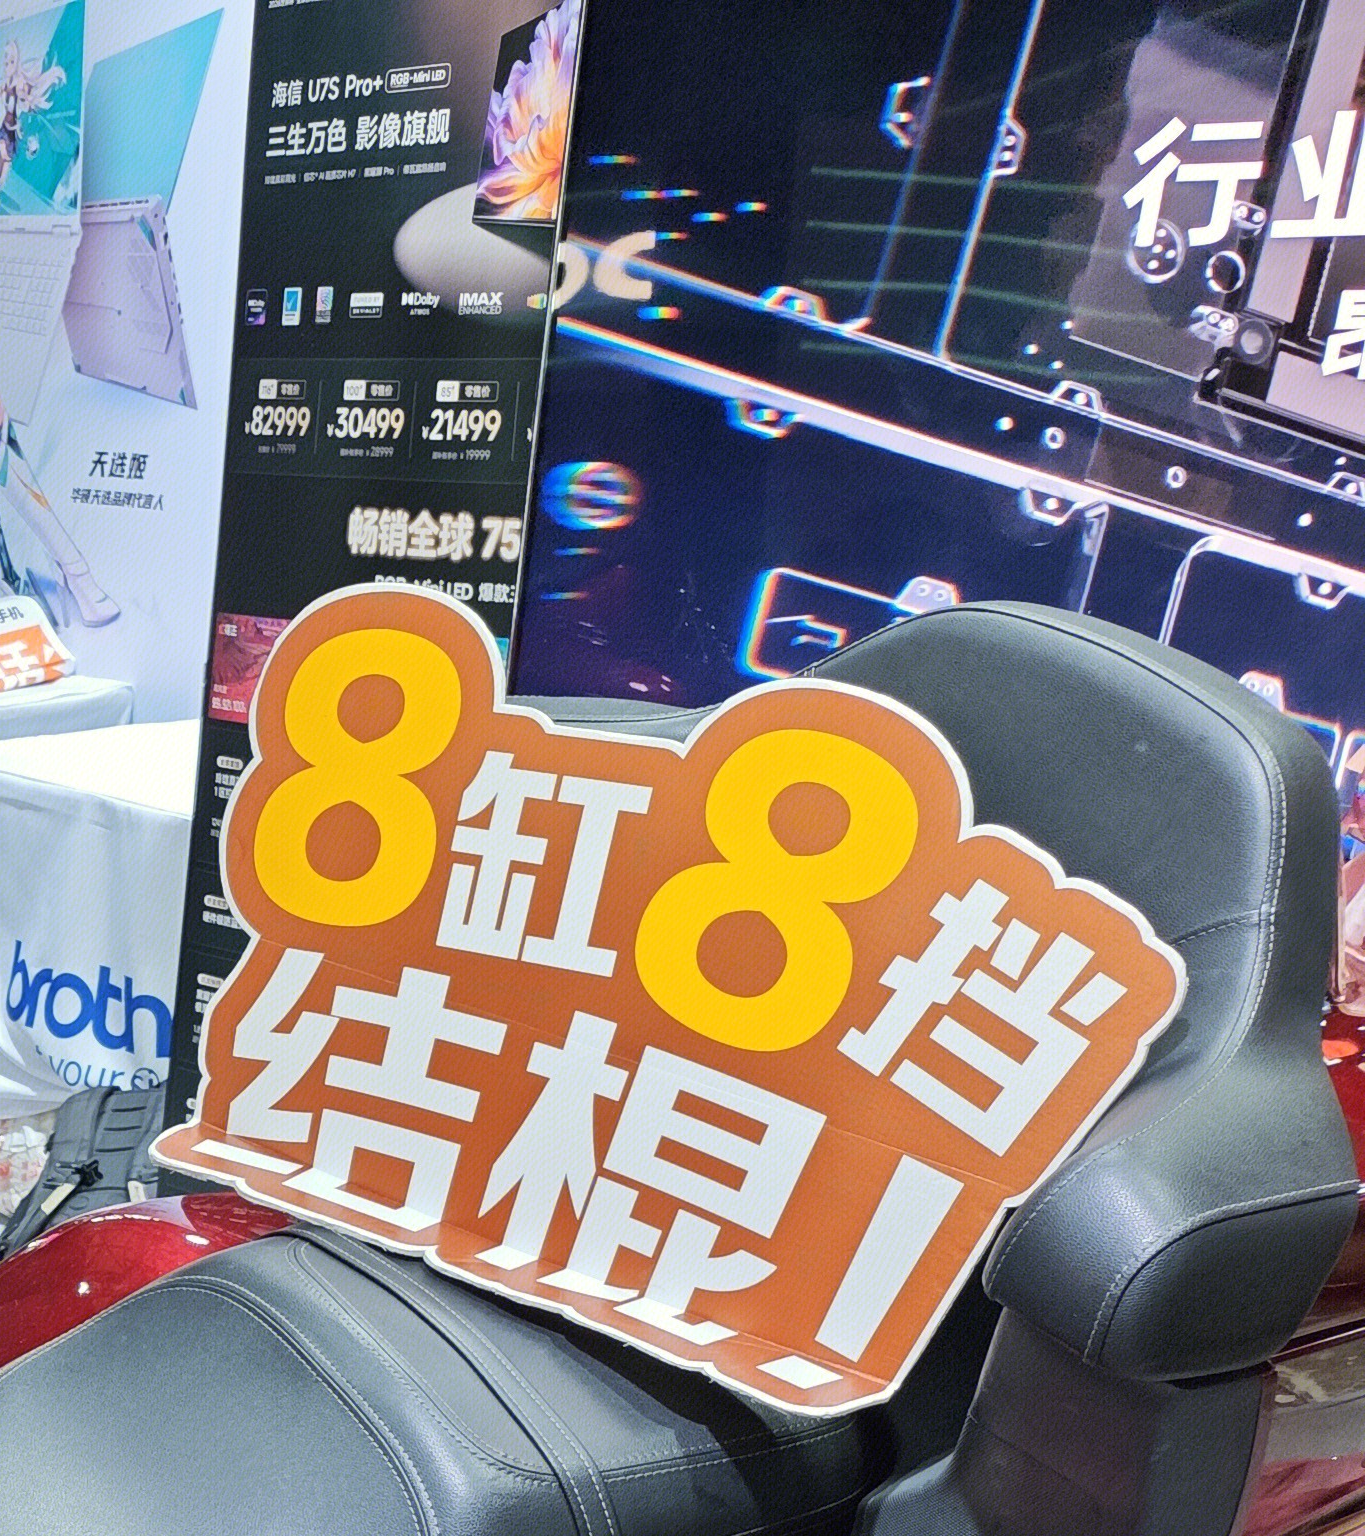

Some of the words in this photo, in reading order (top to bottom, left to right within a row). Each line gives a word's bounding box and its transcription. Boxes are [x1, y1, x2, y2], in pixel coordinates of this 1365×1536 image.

[271, 79, 304, 109] 海信
[308, 76, 340, 103] U7S
[344, 73, 383, 99] Pro+
[265, 118, 347, 157] 三生万色
[355, 108, 451, 152] 影像旗舰
[414, 292, 440, 308] Dolby
[458, 305, 502, 315] ENHANCED
[459, 292, 503, 305] IMAX
[244, 404, 311, 437] ¥82999
[326, 406, 405, 440] ¥30499
[421, 408, 502, 442] ¥21499
[88, 451, 149, 480] 天选姬
[347, 506, 473, 562] 畅销全球
[254, 627, 1128, 1157] 8缸8挡
[6, 940, 173, 1058] broth
